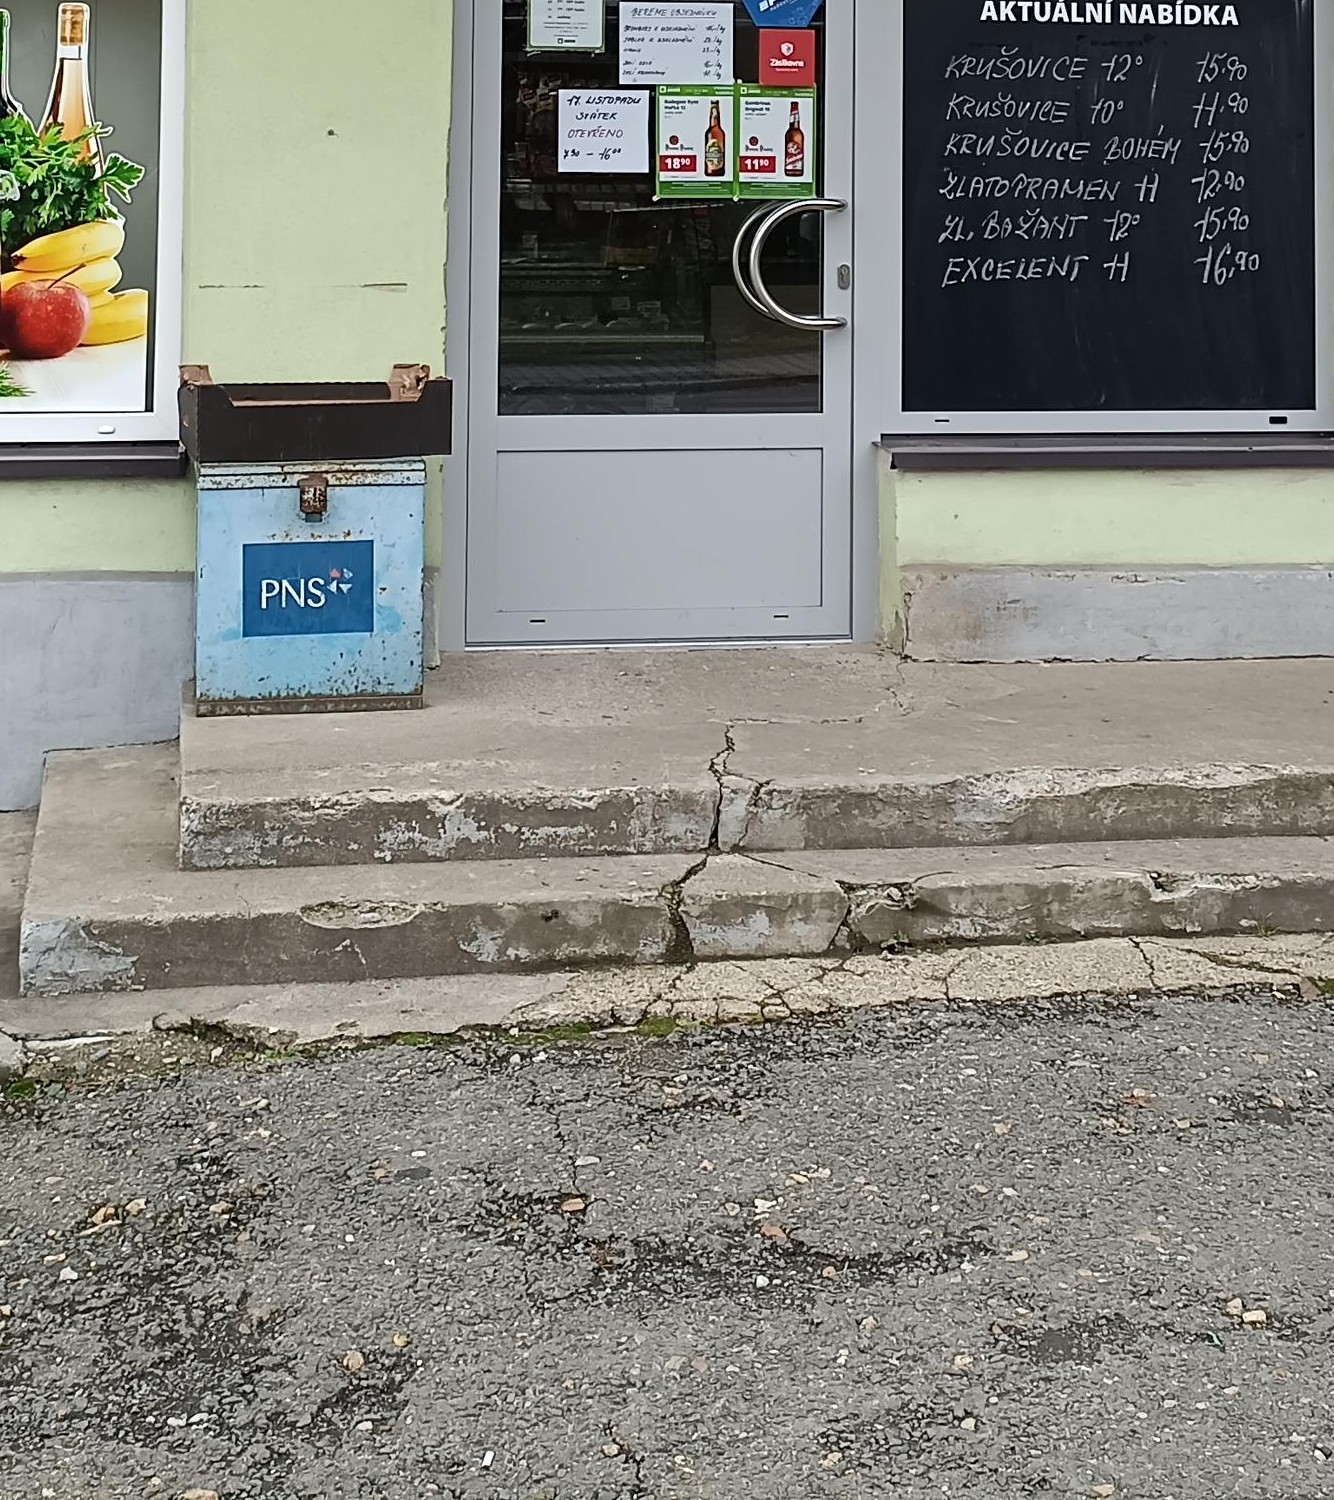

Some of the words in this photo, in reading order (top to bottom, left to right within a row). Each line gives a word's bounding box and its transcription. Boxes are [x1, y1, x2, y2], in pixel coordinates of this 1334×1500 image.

[1118, 0, 1240, 26] NABÍDKA
[944, 46, 1089, 82] KRUŠOVICE
[575, 108, 618, 121] SVÁTEK
[585, 95, 642, 105] LISTOPADU
[945, 92, 1071, 124] KRUŠOVICE
[567, 125, 624, 139] OTEVŘENO
[944, 127, 1091, 160] KRUŠOVICE
[938, 171, 1121, 202] ZLATOPRAMEN
[981, 207, 1089, 240] BAŽANT
[941, 254, 1090, 288] EXCELENT
[260, 576, 327, 610] PNS
